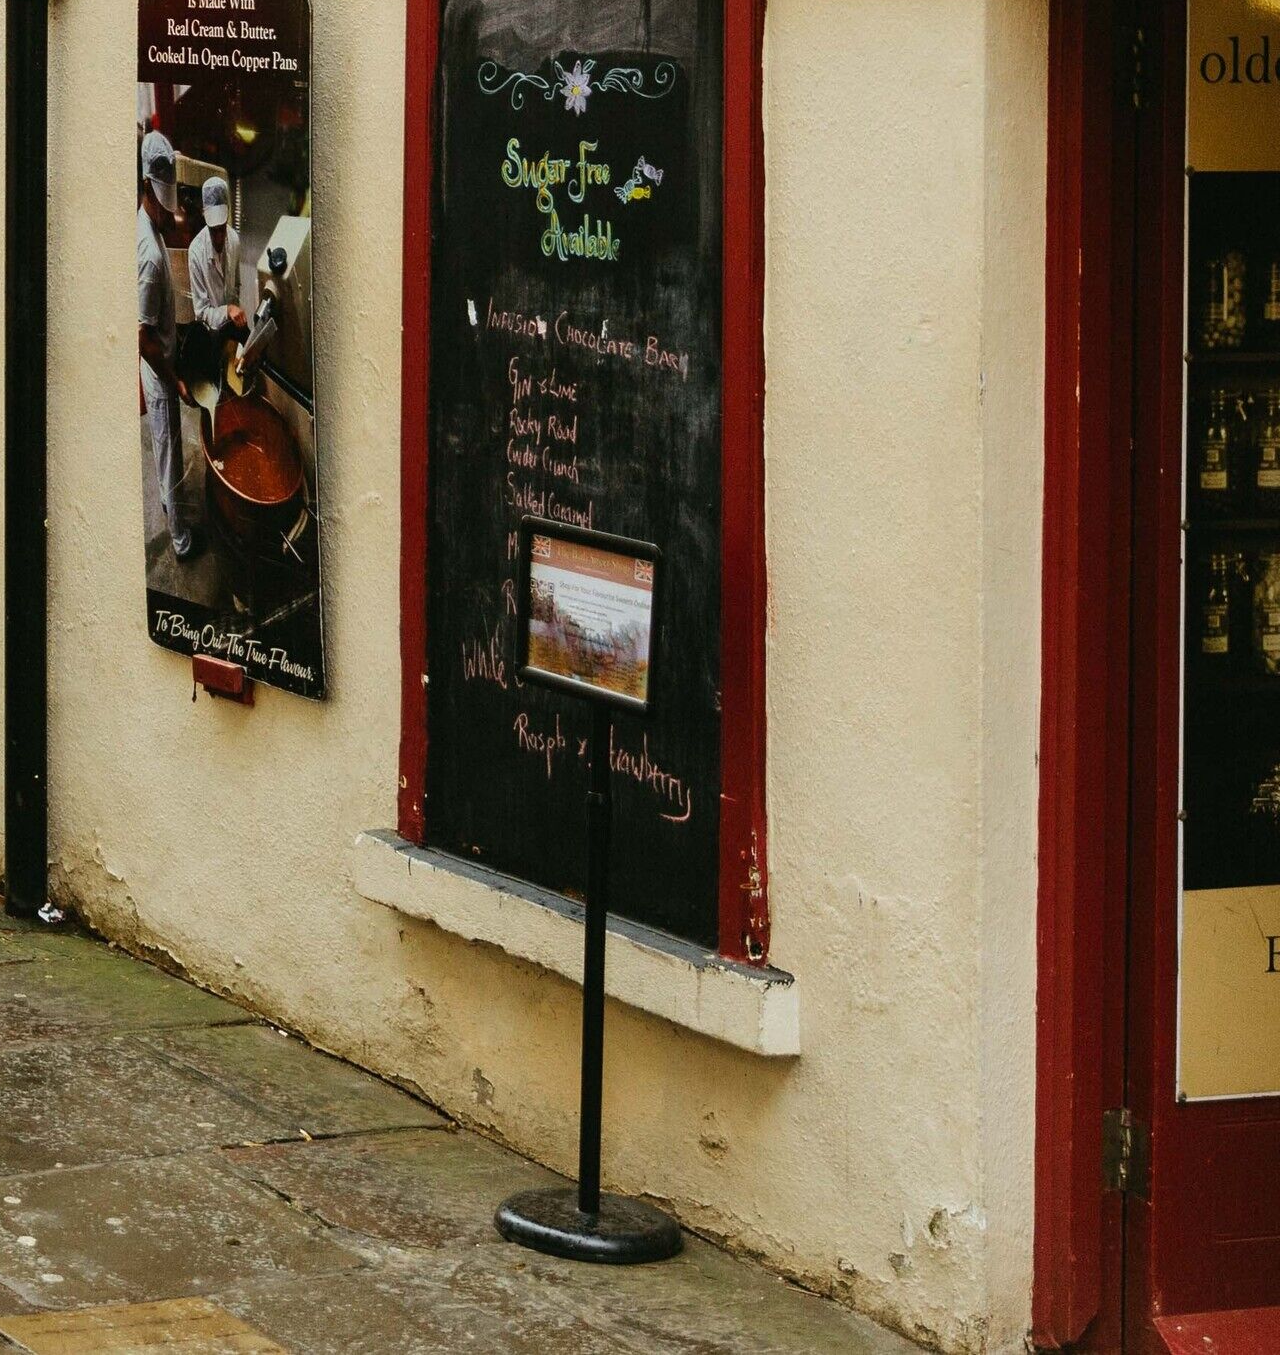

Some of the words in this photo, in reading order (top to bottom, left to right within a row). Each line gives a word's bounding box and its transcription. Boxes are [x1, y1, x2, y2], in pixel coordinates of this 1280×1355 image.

[167, 18, 189, 37] Real
[191, 19, 224, 38] Cream
[226, 20, 238, 39] &
[240, 20, 277, 40] Butter.
[148, 45, 185, 64] Cooked
[187, 47, 199, 65] In
[201, 48, 229, 70] Open
[231, 49, 270, 72] Copper
[272, 51, 298, 71] Pans
[1200, 34, 1280, 84] old
[501, 137, 571, 213] Sugar
[568, 139, 611, 204] Free
[541, 208, 621, 262] Available
[509, 407, 541, 445] Rocky
[547, 415, 578, 444] Road
[542, 446, 580, 484] Crunch
[505, 471, 545, 517] Salted
[547, 492, 593, 530] Caramel
[155, 610, 171, 632] To
[168, 614, 201, 651] Bring
[201, 624, 227, 650] Out
[226, 633, 245, 657] The
[245, 640, 268, 664] True
[268, 648, 314, 682] Flavour.
